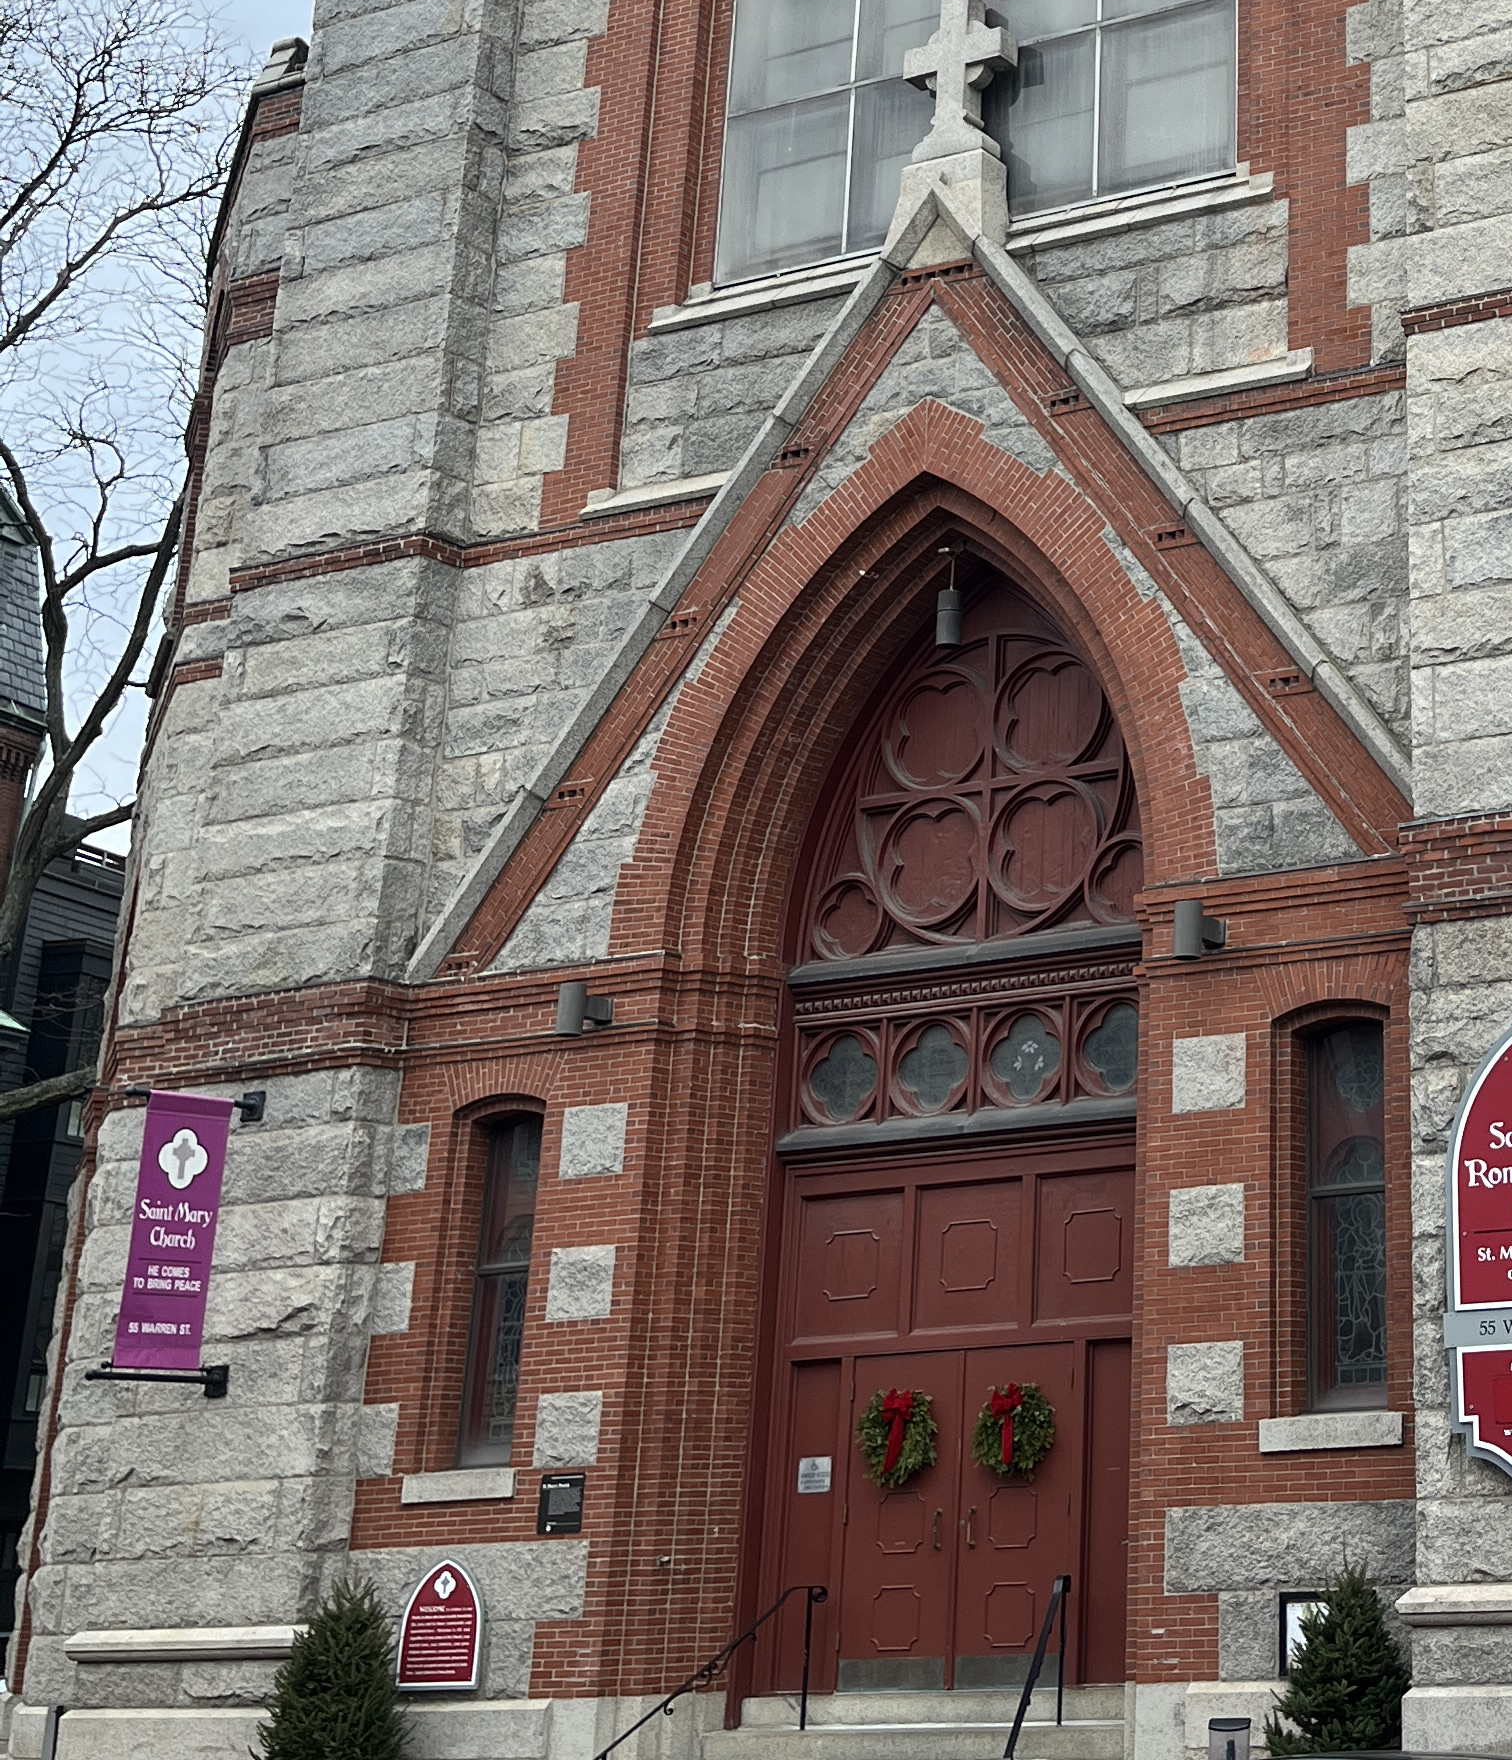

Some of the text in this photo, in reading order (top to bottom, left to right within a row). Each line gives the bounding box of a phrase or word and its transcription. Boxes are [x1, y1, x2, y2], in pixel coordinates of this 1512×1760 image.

[139, 1199, 213, 1228] Saint Mary
[150, 1226, 195, 1250] Church
[1477, 1247, 1496, 1262] St.
[147, 1265, 190, 1278] HE COMES
[133, 1277, 201, 1291] TO BRING PEACE
[128, 1322, 139, 1333] 55
[141, 1322, 177, 1335] WARREN
[1479, 1320, 1496, 1336] 55
